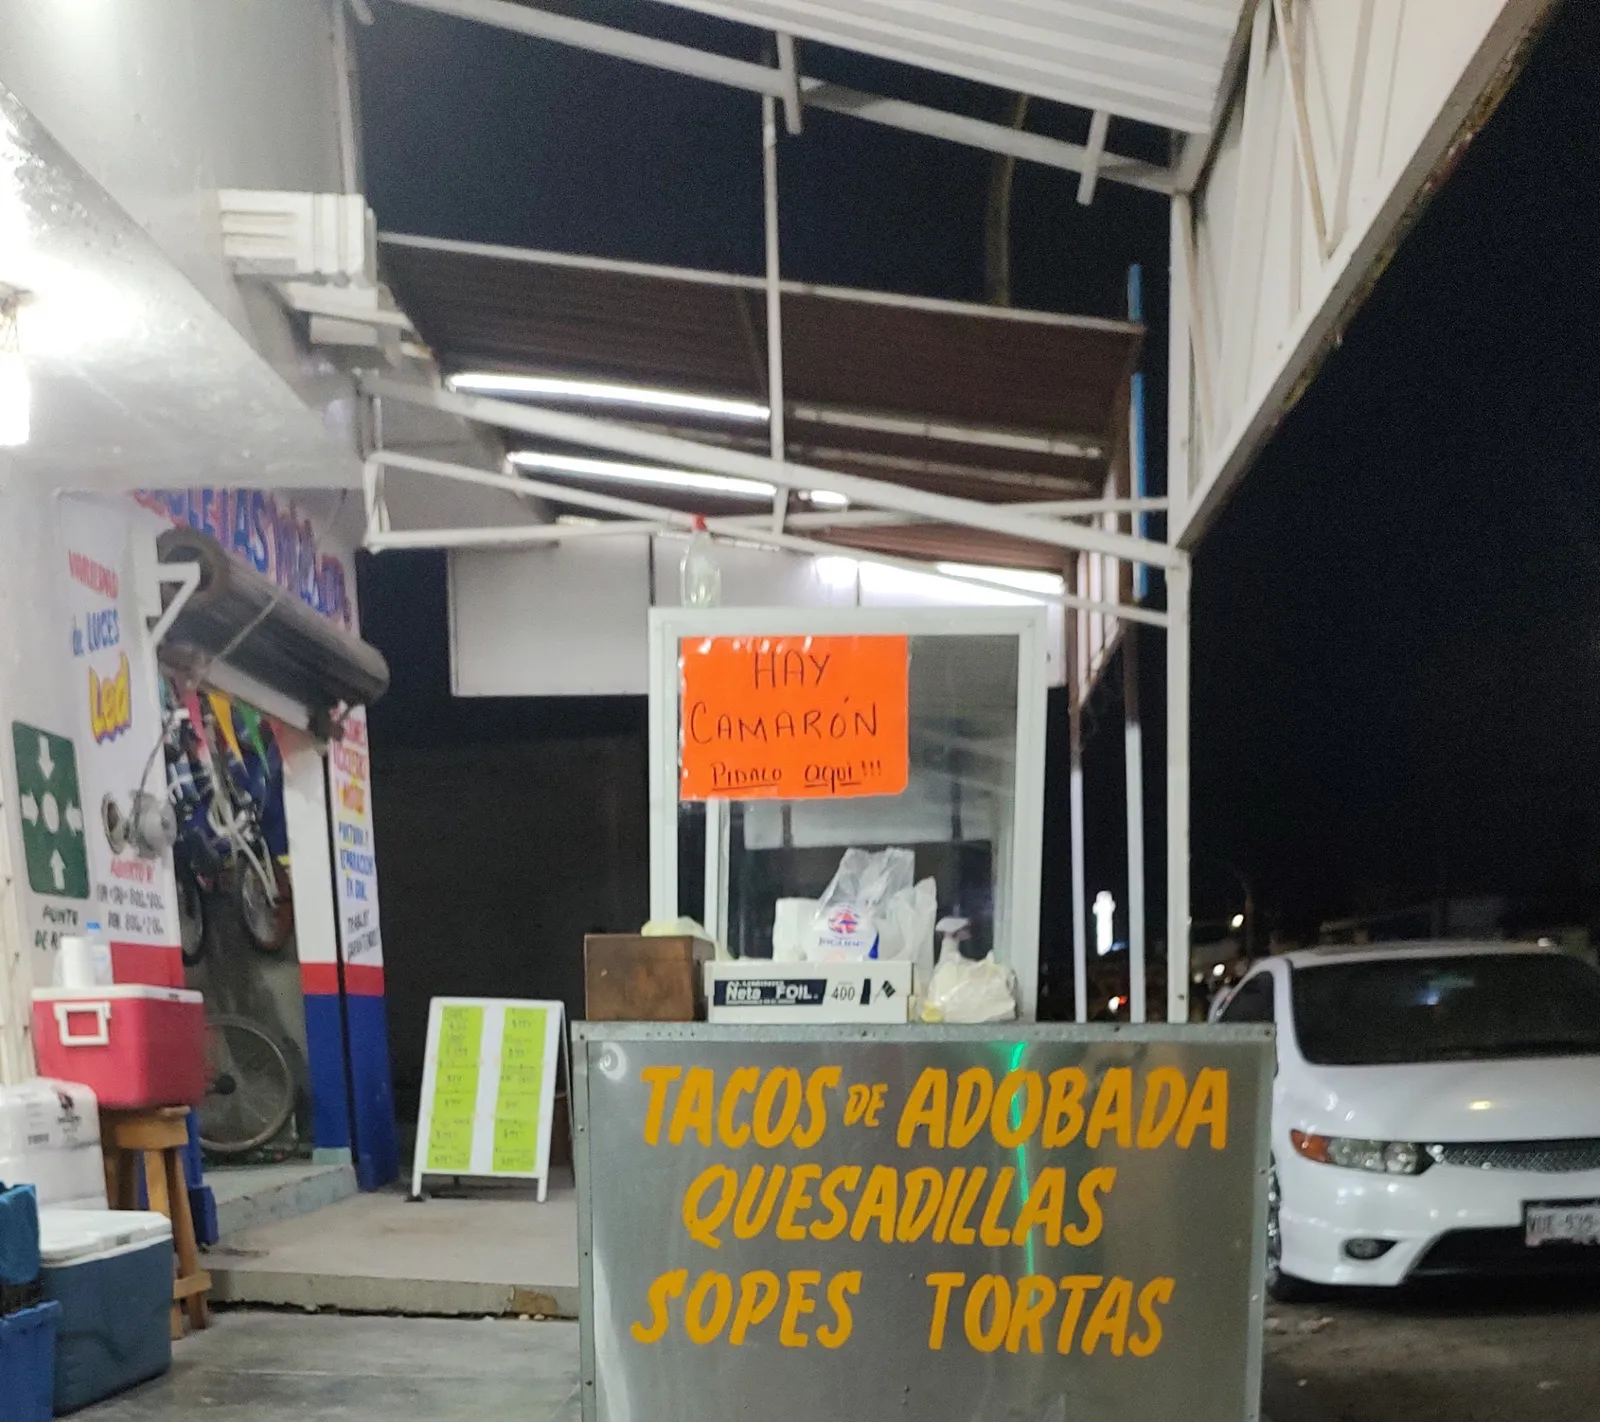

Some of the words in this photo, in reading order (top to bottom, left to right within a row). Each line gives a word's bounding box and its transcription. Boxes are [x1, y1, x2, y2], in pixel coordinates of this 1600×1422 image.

[87, 608, 121, 652] LUCES
[753, 650, 831, 689] HAY
[690, 696, 877, 745] CAMARÓN
[830, 986, 856, 1002] 400
[639, 1065, 842, 1150] TACOS
[843, 1082, 888, 1129] DE
[897, 1066, 1230, 1151] ADOBADA
[681, 1163, 1118, 1250] QUESADILLAS
[630, 1268, 863, 1350] SOPES
[925, 1270, 1176, 1358] TORTAS
